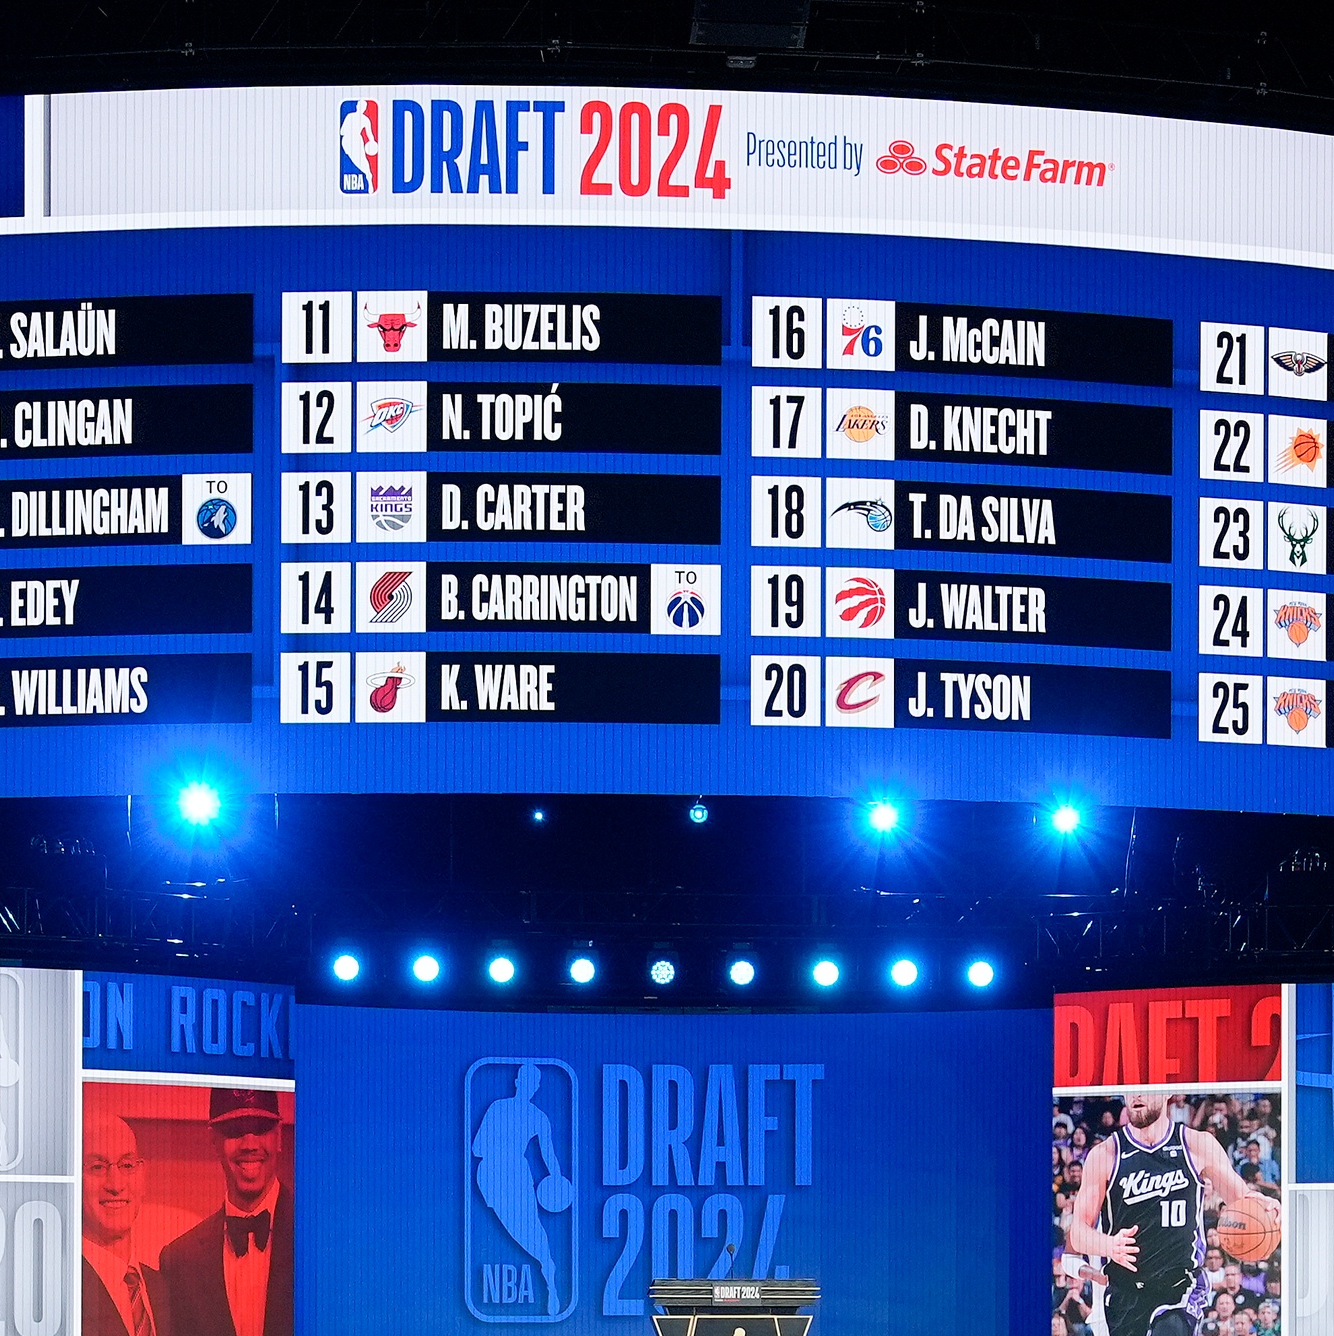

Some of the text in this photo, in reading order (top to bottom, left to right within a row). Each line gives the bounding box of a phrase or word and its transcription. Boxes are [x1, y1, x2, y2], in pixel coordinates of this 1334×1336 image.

[392, 99, 1107, 199] DRAFT 2024 Presented by State Farm
[344, 173, 364, 190] NBA
[10, 303, 115, 358] SALAÜN
[302, 301, 600, 354] 11 M. BUZELIS
[769, 306, 1045, 366] 16 J. McCAIN
[843, 323, 882, 357] 76
[1216, 331, 1246, 385] 21
[15, 399, 132, 447] CLINGAN
[300, 383, 561, 444] 12 N. TOPIĆ
[371, 402, 403, 427] OKC
[770, 395, 1051, 455] 17 D. KNECHT
[836, 414, 887, 434] LAKERS
[1214, 419, 1250, 473] 22
[12, 488, 168, 537] DILLINGHAM
[206, 481, 228, 494] TO
[299, 480, 585, 535] 13 D. CARTER
[371, 504, 412, 512] KINGS
[768, 485, 1055, 544] 18 T. DA SILVA
[1213, 506, 1249, 560] 23
[11, 580, 79, 626] EDEY
[299, 571, 637, 624] 14 B. CARRINGTON
[675, 571, 696, 584] TO
[768, 574, 1046, 632] 19 J. WALTER
[1213, 594, 1249, 647] 24
[1276, 605, 1319, 624] KNICKS
[12, 667, 147, 715] WILLIAMS
[298, 661, 555, 715] 15 K. WARE
[765, 663, 1030, 720] 20 J. TYSON
[1212, 682, 1248, 735] 25
[602, 1064, 825, 1187] DRAFT
[1119, 1169, 1189, 1205] Kings
[1160, 1200, 1186, 1227] 10
[602, 1194, 790, 1316] 2024
[482, 1263, 534, 1305] NBA
[721, 1287, 760, 1298] DRAFT 2024
